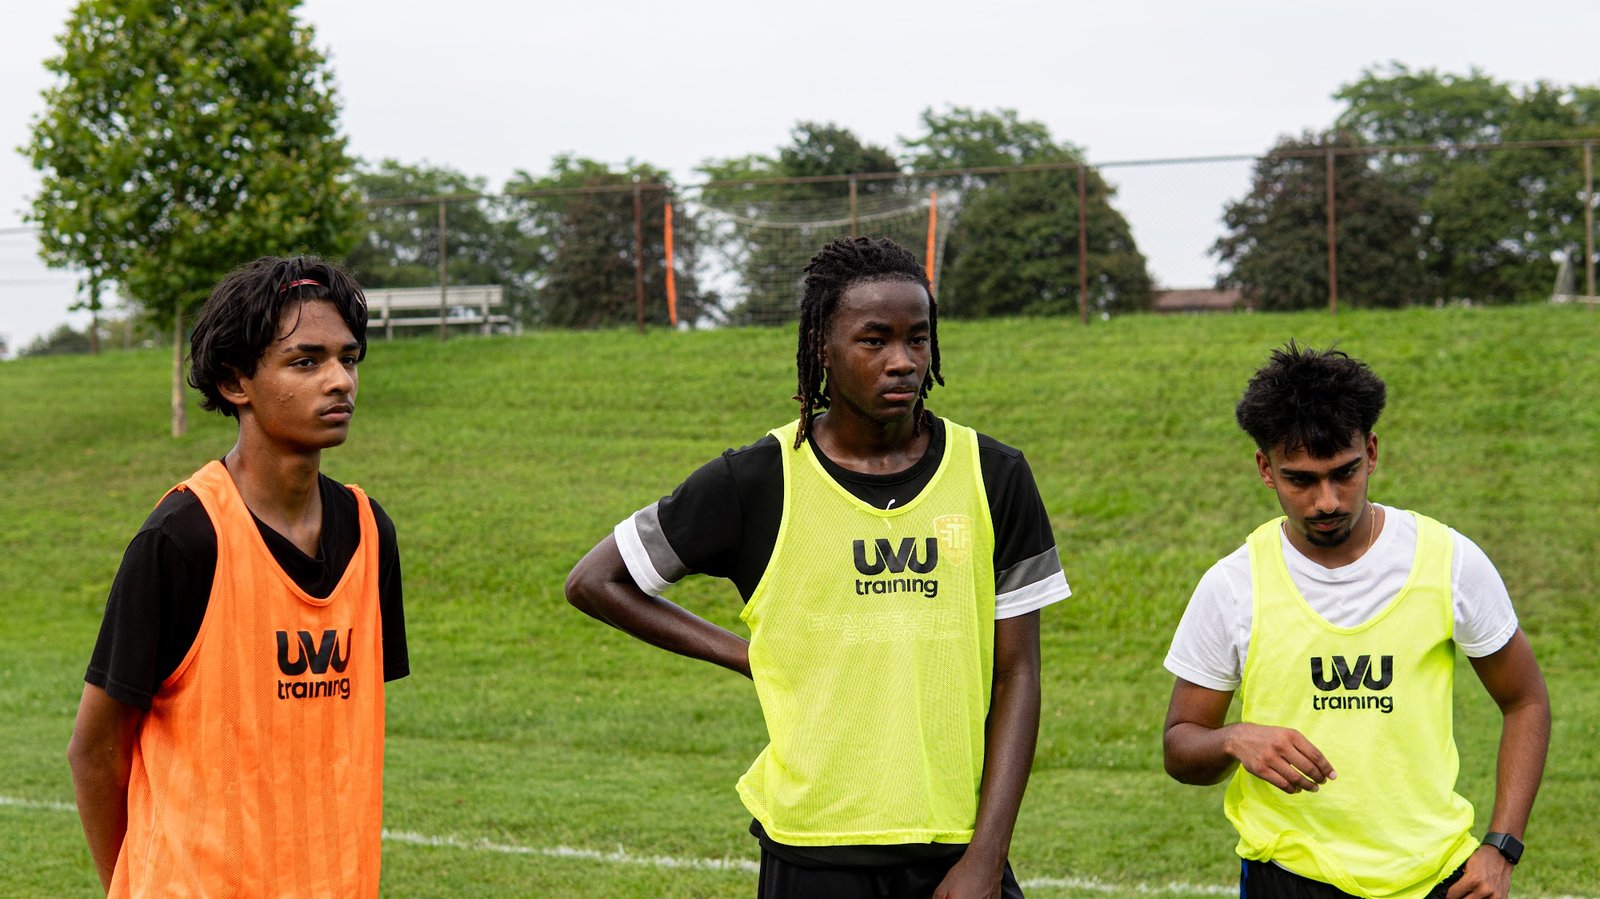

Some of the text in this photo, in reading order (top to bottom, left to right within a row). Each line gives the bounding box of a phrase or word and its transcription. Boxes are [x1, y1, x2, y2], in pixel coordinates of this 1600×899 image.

[853, 537, 938, 575] UVU
[855, 578, 938, 598] training
[276, 628, 352, 676] UVU
[1310, 655, 1393, 691] UVU
[277, 678, 350, 699] training
[1313, 694, 1393, 713] training
